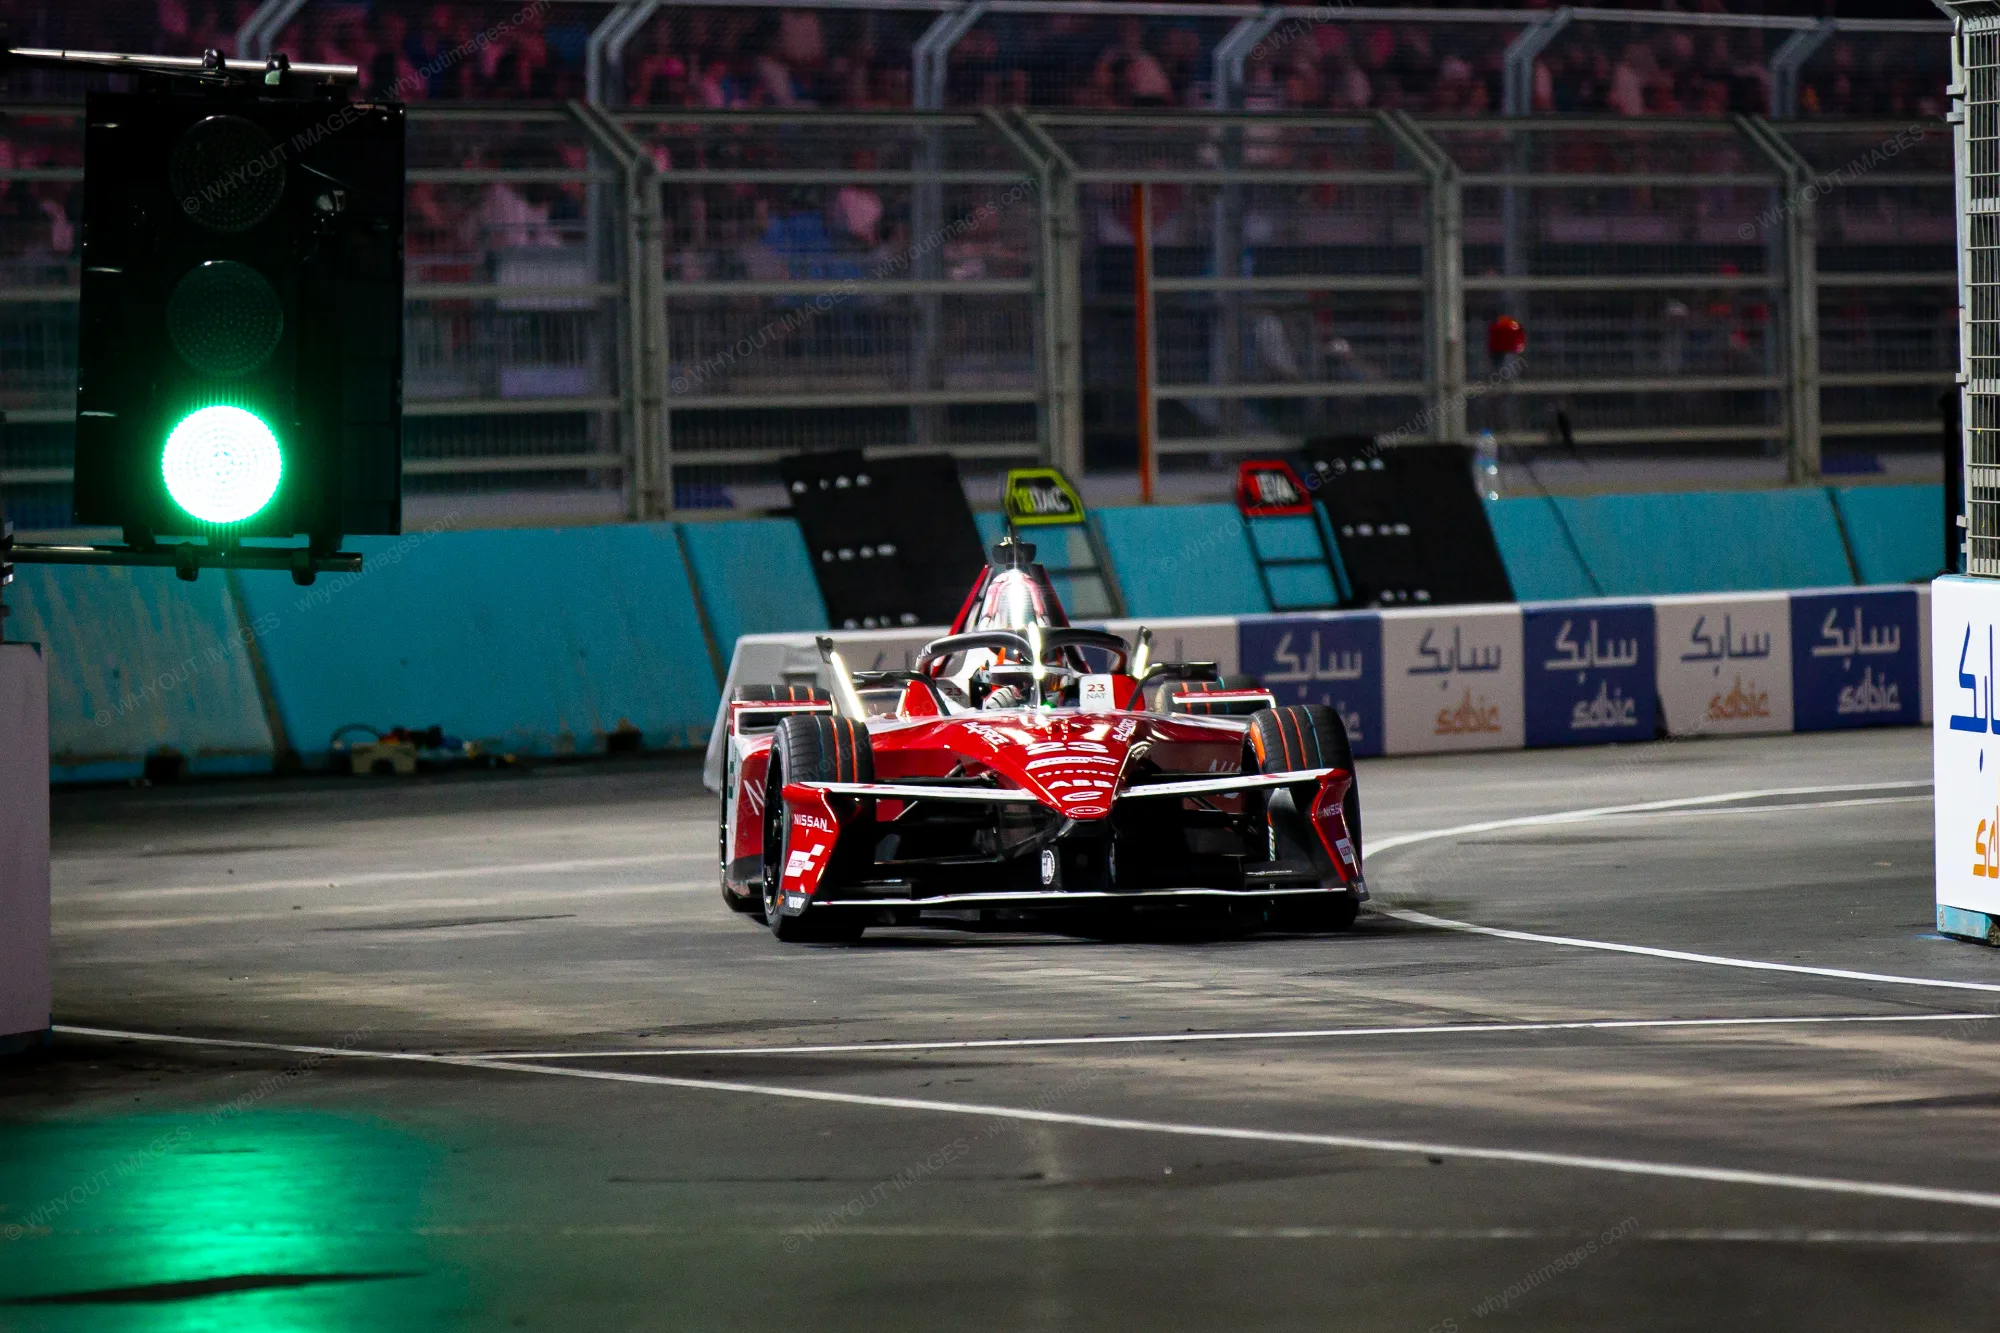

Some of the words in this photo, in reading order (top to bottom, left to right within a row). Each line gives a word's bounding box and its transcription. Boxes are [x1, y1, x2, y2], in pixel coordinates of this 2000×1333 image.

[1408, 626, 1500, 691] سابك
[1544, 619, 1638, 684] سابك
[1681, 613, 1770, 676] سابك
[1813, 607, 1900, 670] سابك
[1087, 684, 1106, 693] 23
[1264, 630, 1362, 698] سابك
[1086, 692, 1107, 700] NAT
[1434, 686, 1500, 735] sabic
[1571, 679, 1638, 729] sabic
[1707, 672, 1770, 721] sabic
[1838, 666, 1901, 714] sabic
[1025, 741, 1109, 756] 23
[1037, 769, 1116, 778] nismo
[1047, 779, 1113, 790] ABB
[794, 813, 829, 831] NISSAN
